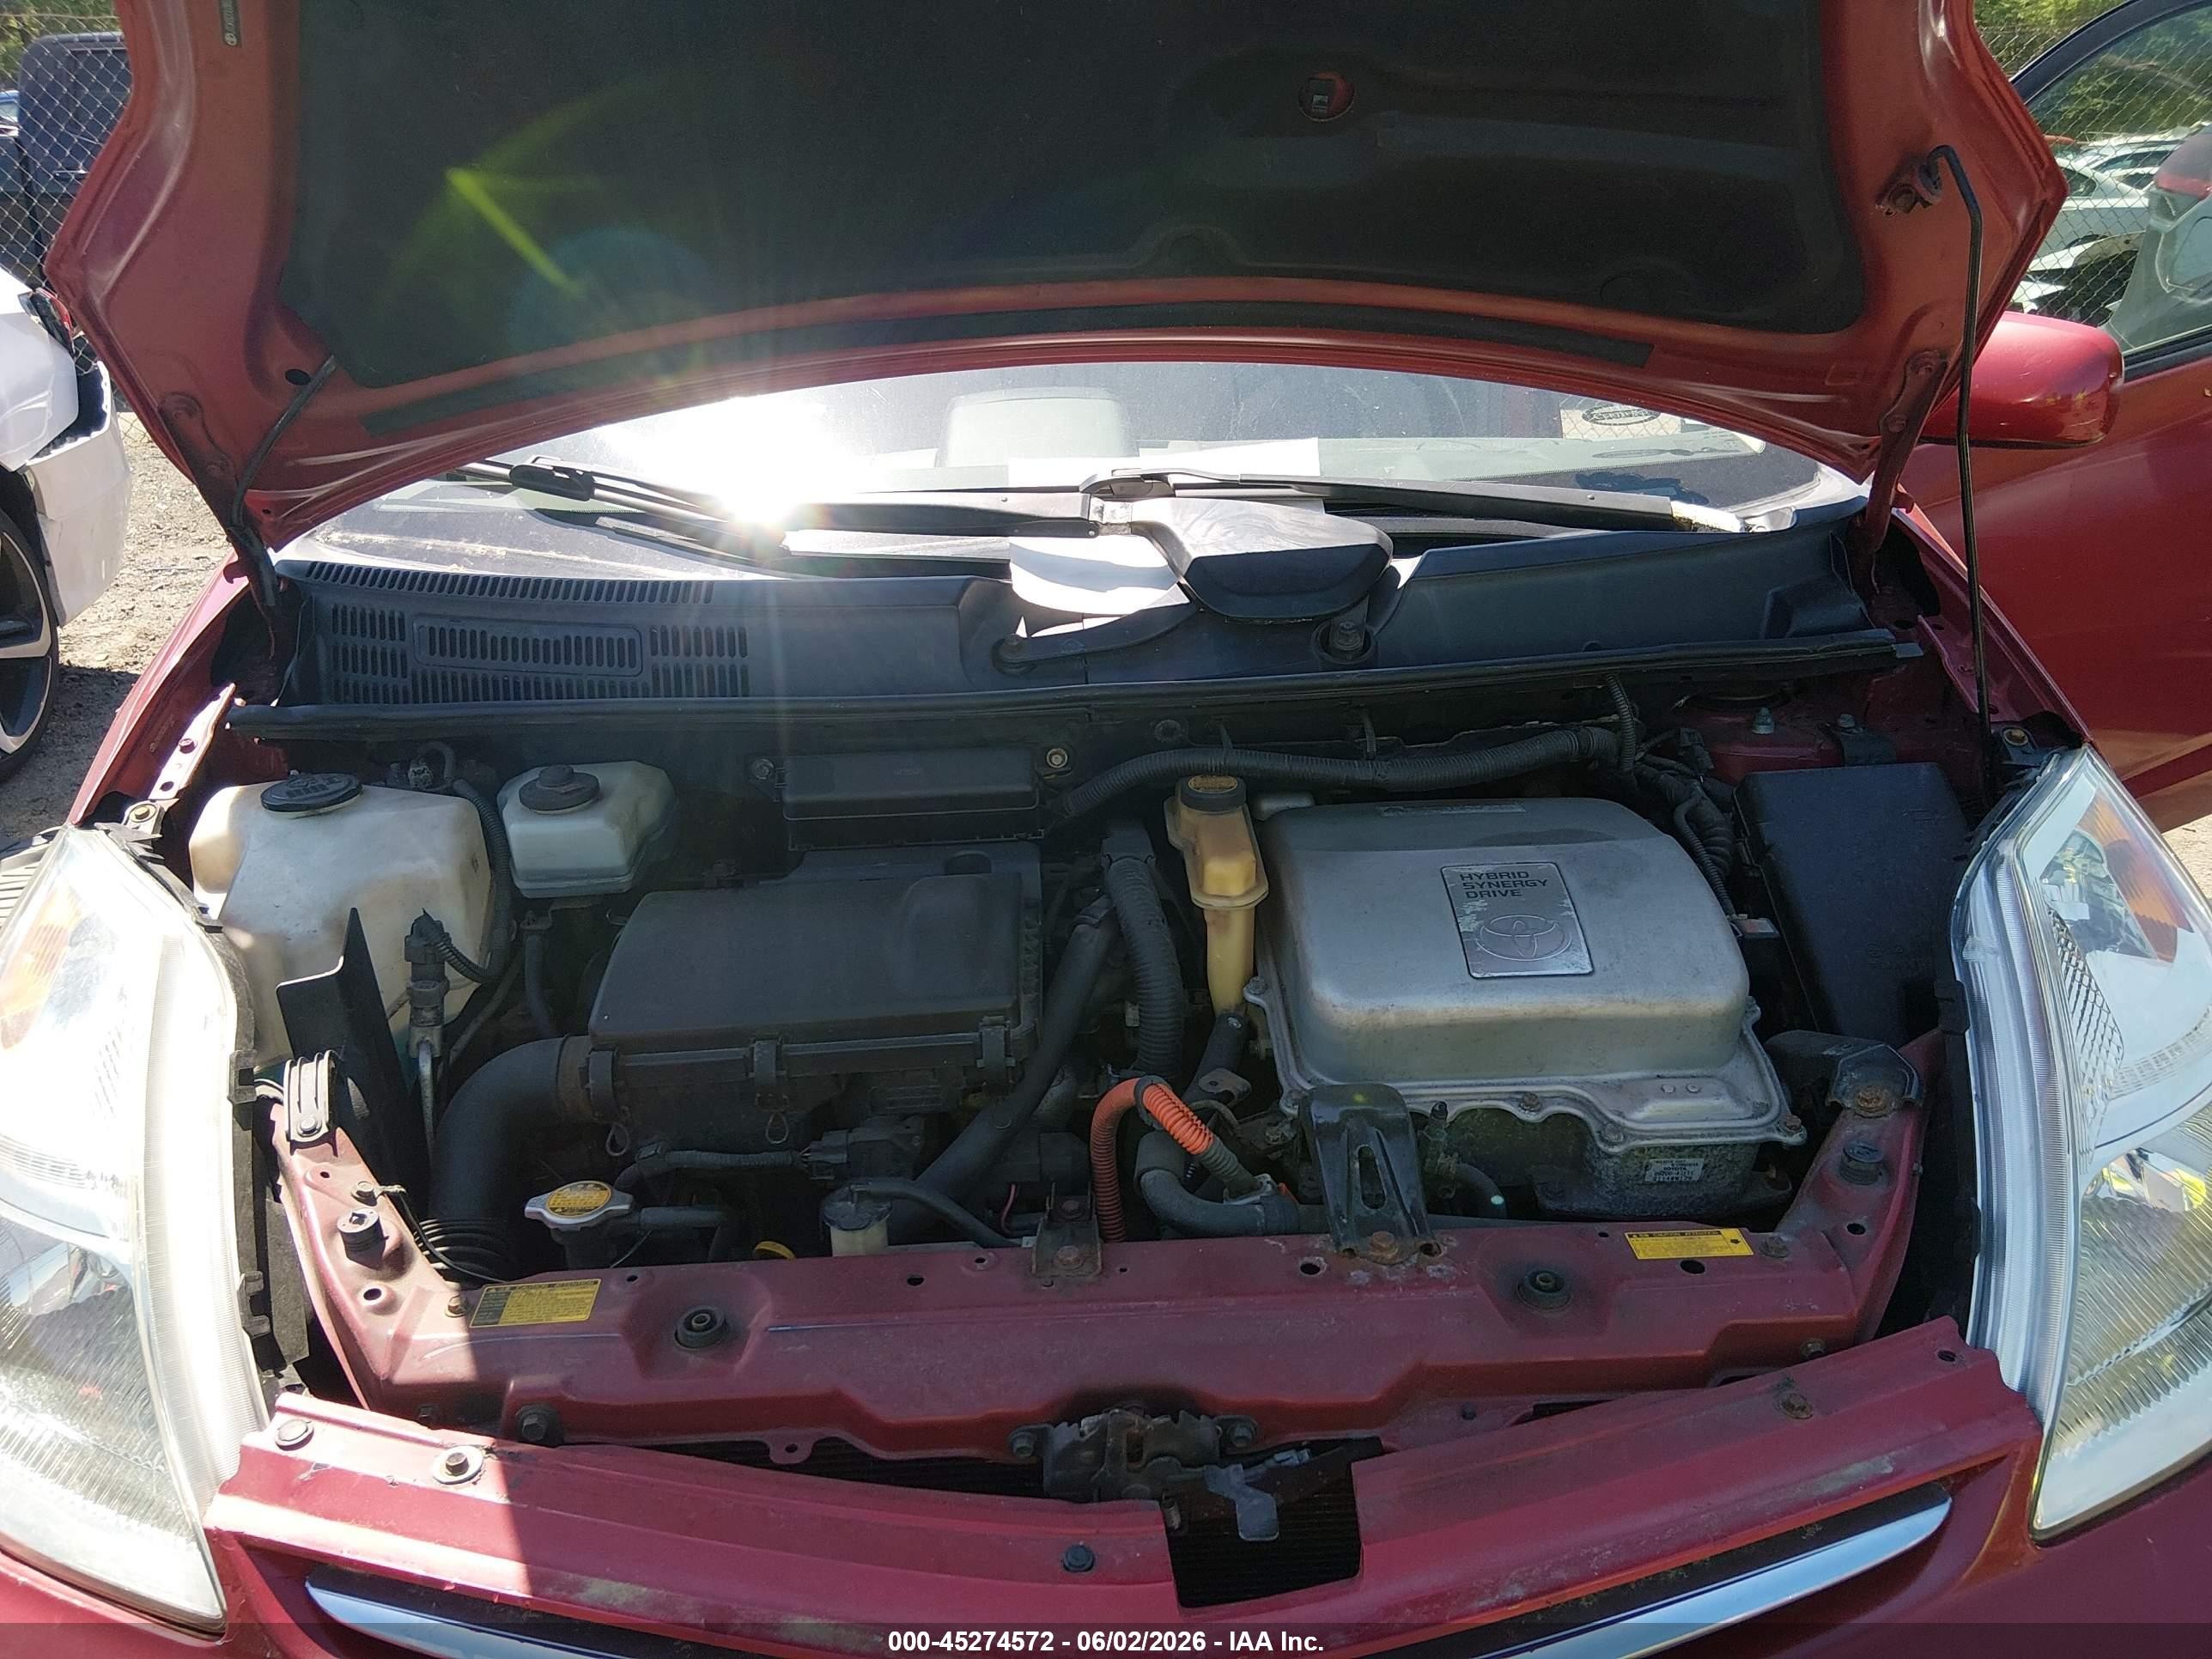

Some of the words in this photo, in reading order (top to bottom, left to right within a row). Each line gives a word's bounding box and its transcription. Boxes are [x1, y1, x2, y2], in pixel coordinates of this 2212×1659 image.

[1460, 871, 1530, 881] HYBRID
[1462, 878, 1547, 890] SYNERGY
[1466, 889, 1522, 899] DRIVE
